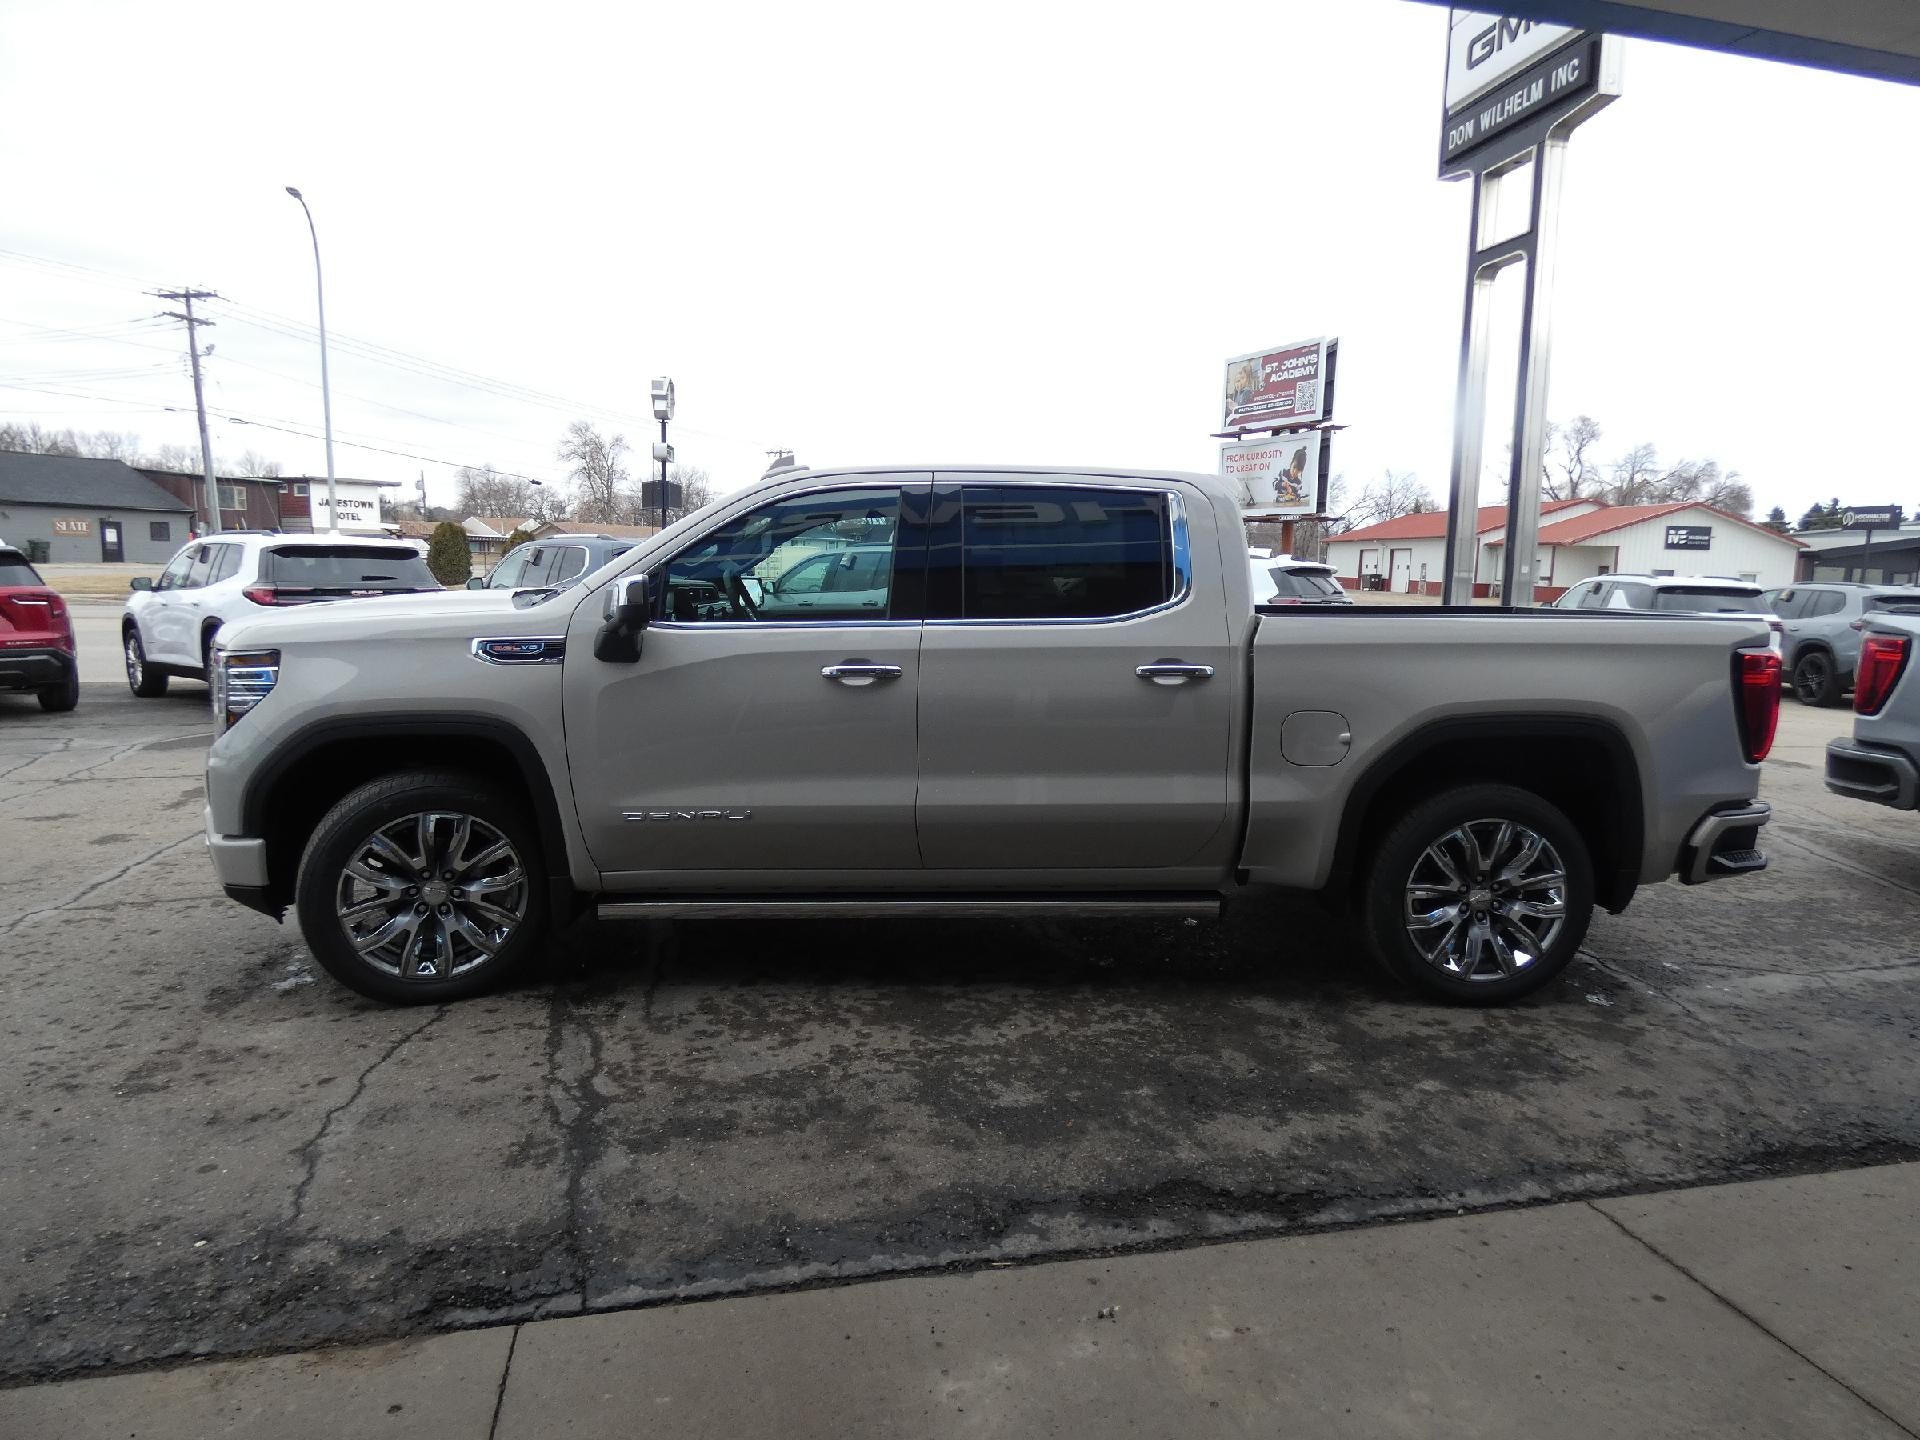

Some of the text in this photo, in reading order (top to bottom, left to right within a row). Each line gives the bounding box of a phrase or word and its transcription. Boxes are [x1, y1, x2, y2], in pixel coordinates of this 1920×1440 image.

[1466, 15, 1540, 71] GM
[1449, 58, 1580, 150] DON WILHELM INC
[1265, 353, 1318, 373] ST. JOHN'S
[1269, 365, 1317, 383] ACADEMY
[1226, 449, 1283, 463] FROM CURIOSITY
[1225, 462, 1271, 474] TO CREATON
[318, 498, 374, 509] JAESTOWN
[621, 810, 752, 821] DENALI
